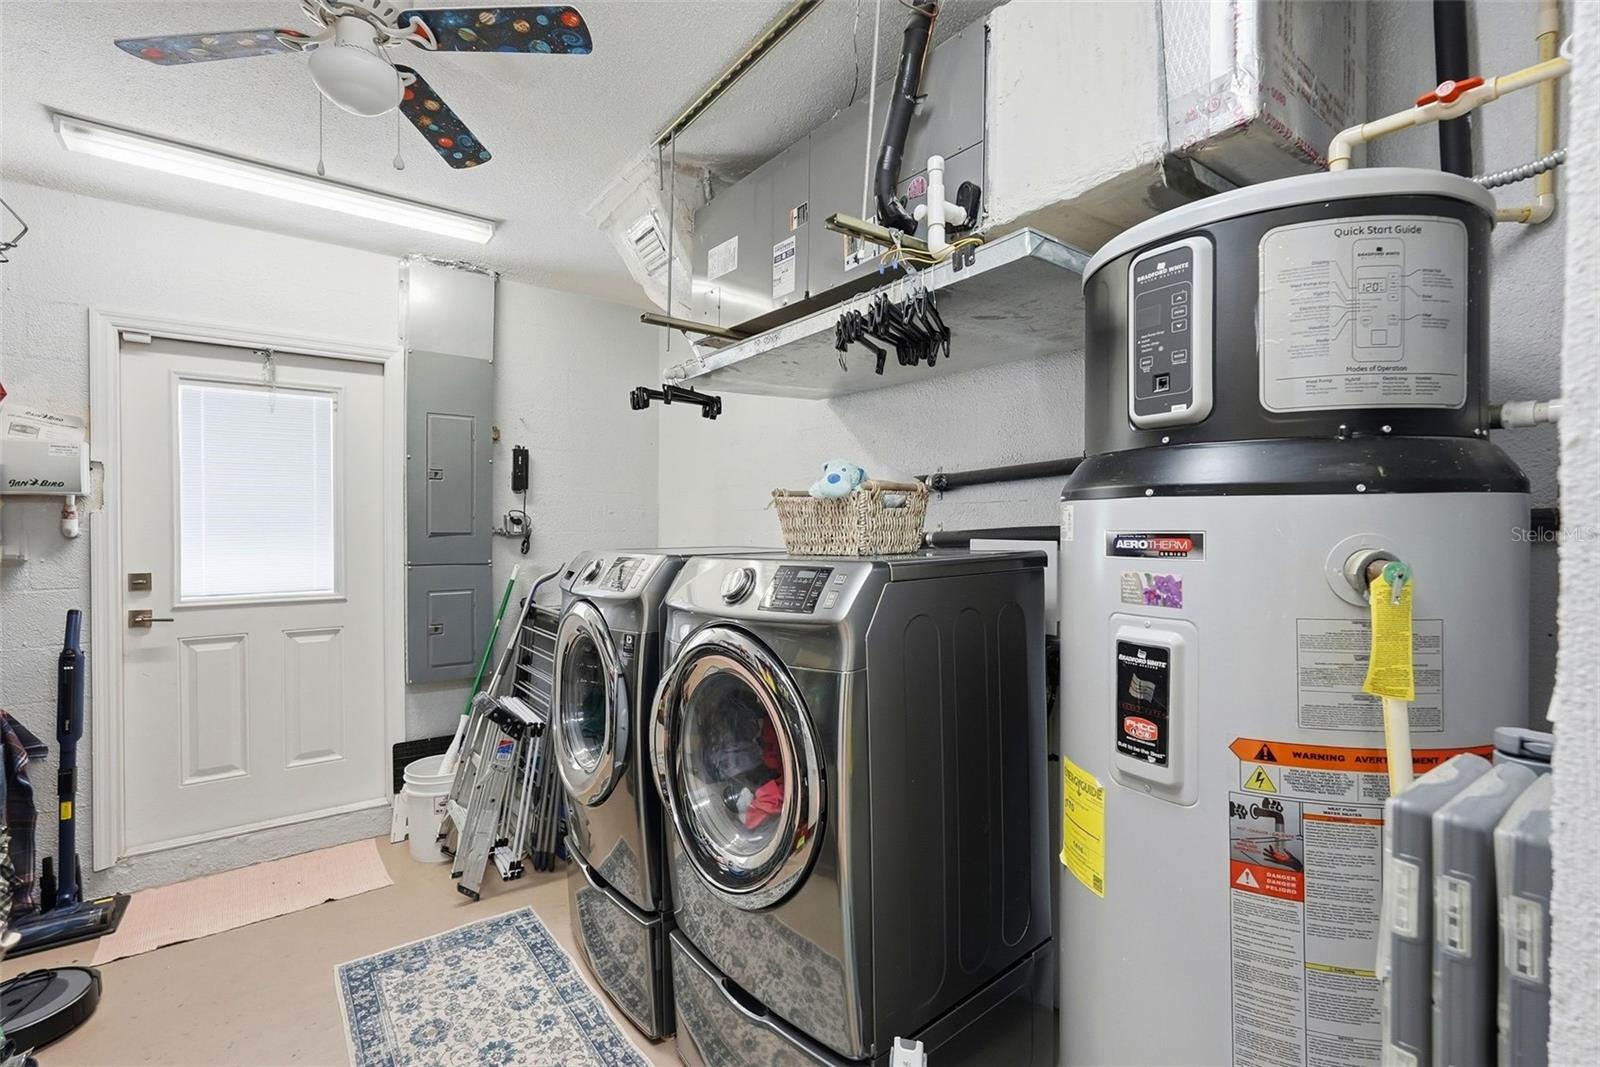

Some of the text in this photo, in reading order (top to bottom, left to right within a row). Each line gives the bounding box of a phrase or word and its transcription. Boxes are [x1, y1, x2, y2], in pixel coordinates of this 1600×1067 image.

[1334, 225, 1422, 238] Quick Start Guide
[1137, 261, 1189, 282] BRADFORD WHITE
[1377, 365, 1408, 373] Operation
[1115, 540, 1188, 549] AEROTHERM
[1118, 653, 1168, 669] BRADFORD WHITE
[1292, 751, 1346, 762] WARNING
[1266, 872, 1296, 882] DANGER
[1266, 879, 1297, 888] DANGER
[1265, 885, 1297, 895] PELIGRO
